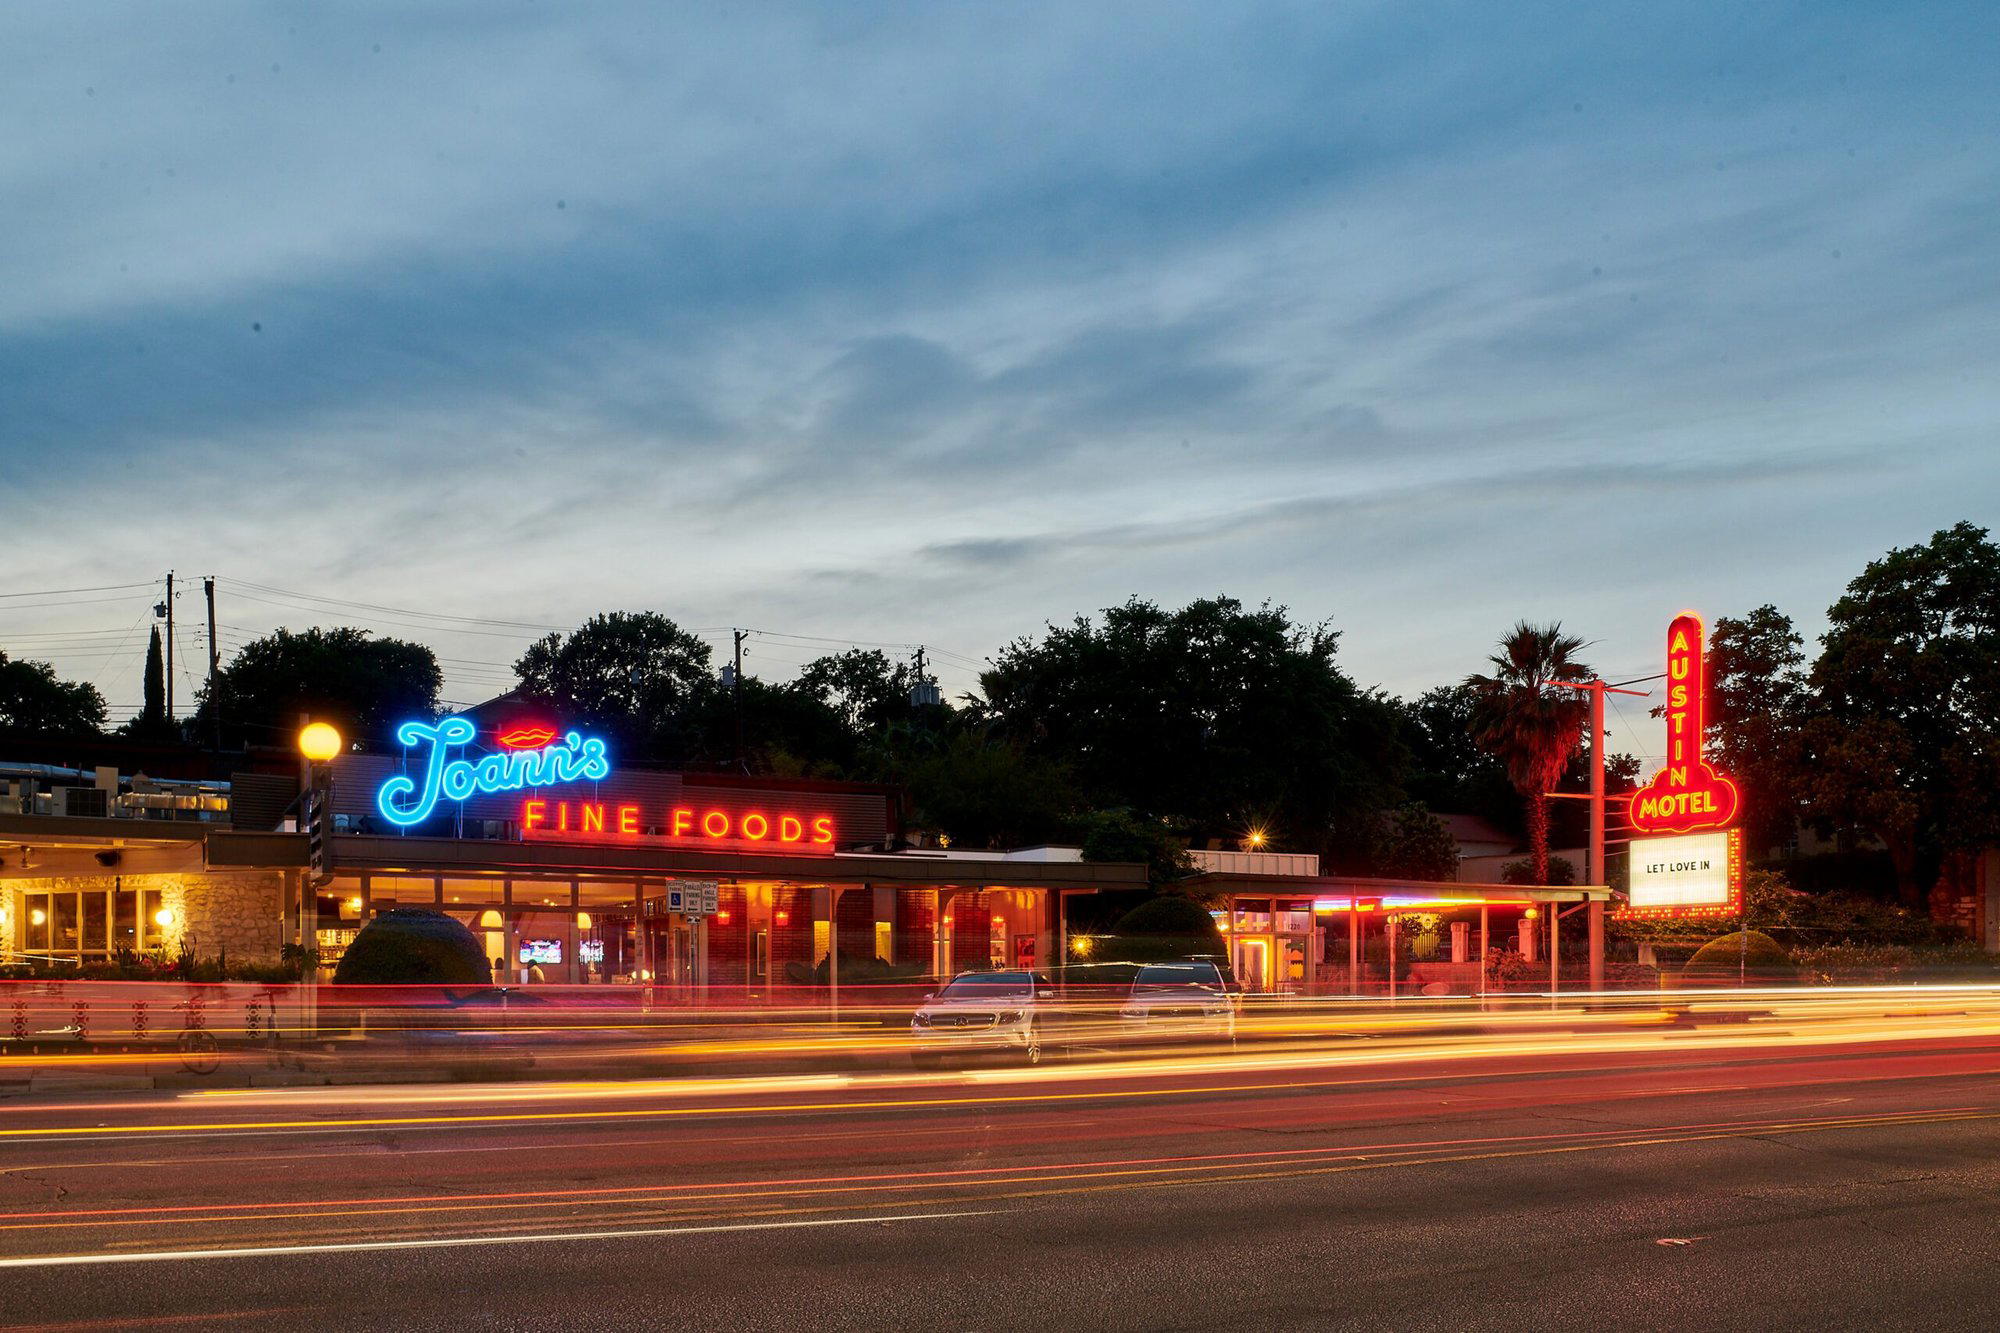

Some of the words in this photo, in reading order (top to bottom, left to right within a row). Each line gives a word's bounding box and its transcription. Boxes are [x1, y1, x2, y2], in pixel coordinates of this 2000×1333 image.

[1670, 631, 1688, 787] AUSTIN
[378, 717, 609, 825] Joann's
[526, 801, 639, 834] FINE
[673, 811, 832, 843] FOODS
[1639, 791, 1717, 819] MOTEL
[1647, 864, 1665, 873] LET
[1670, 861, 1696, 872] LOVE
[1700, 860, 1710, 870] IN
